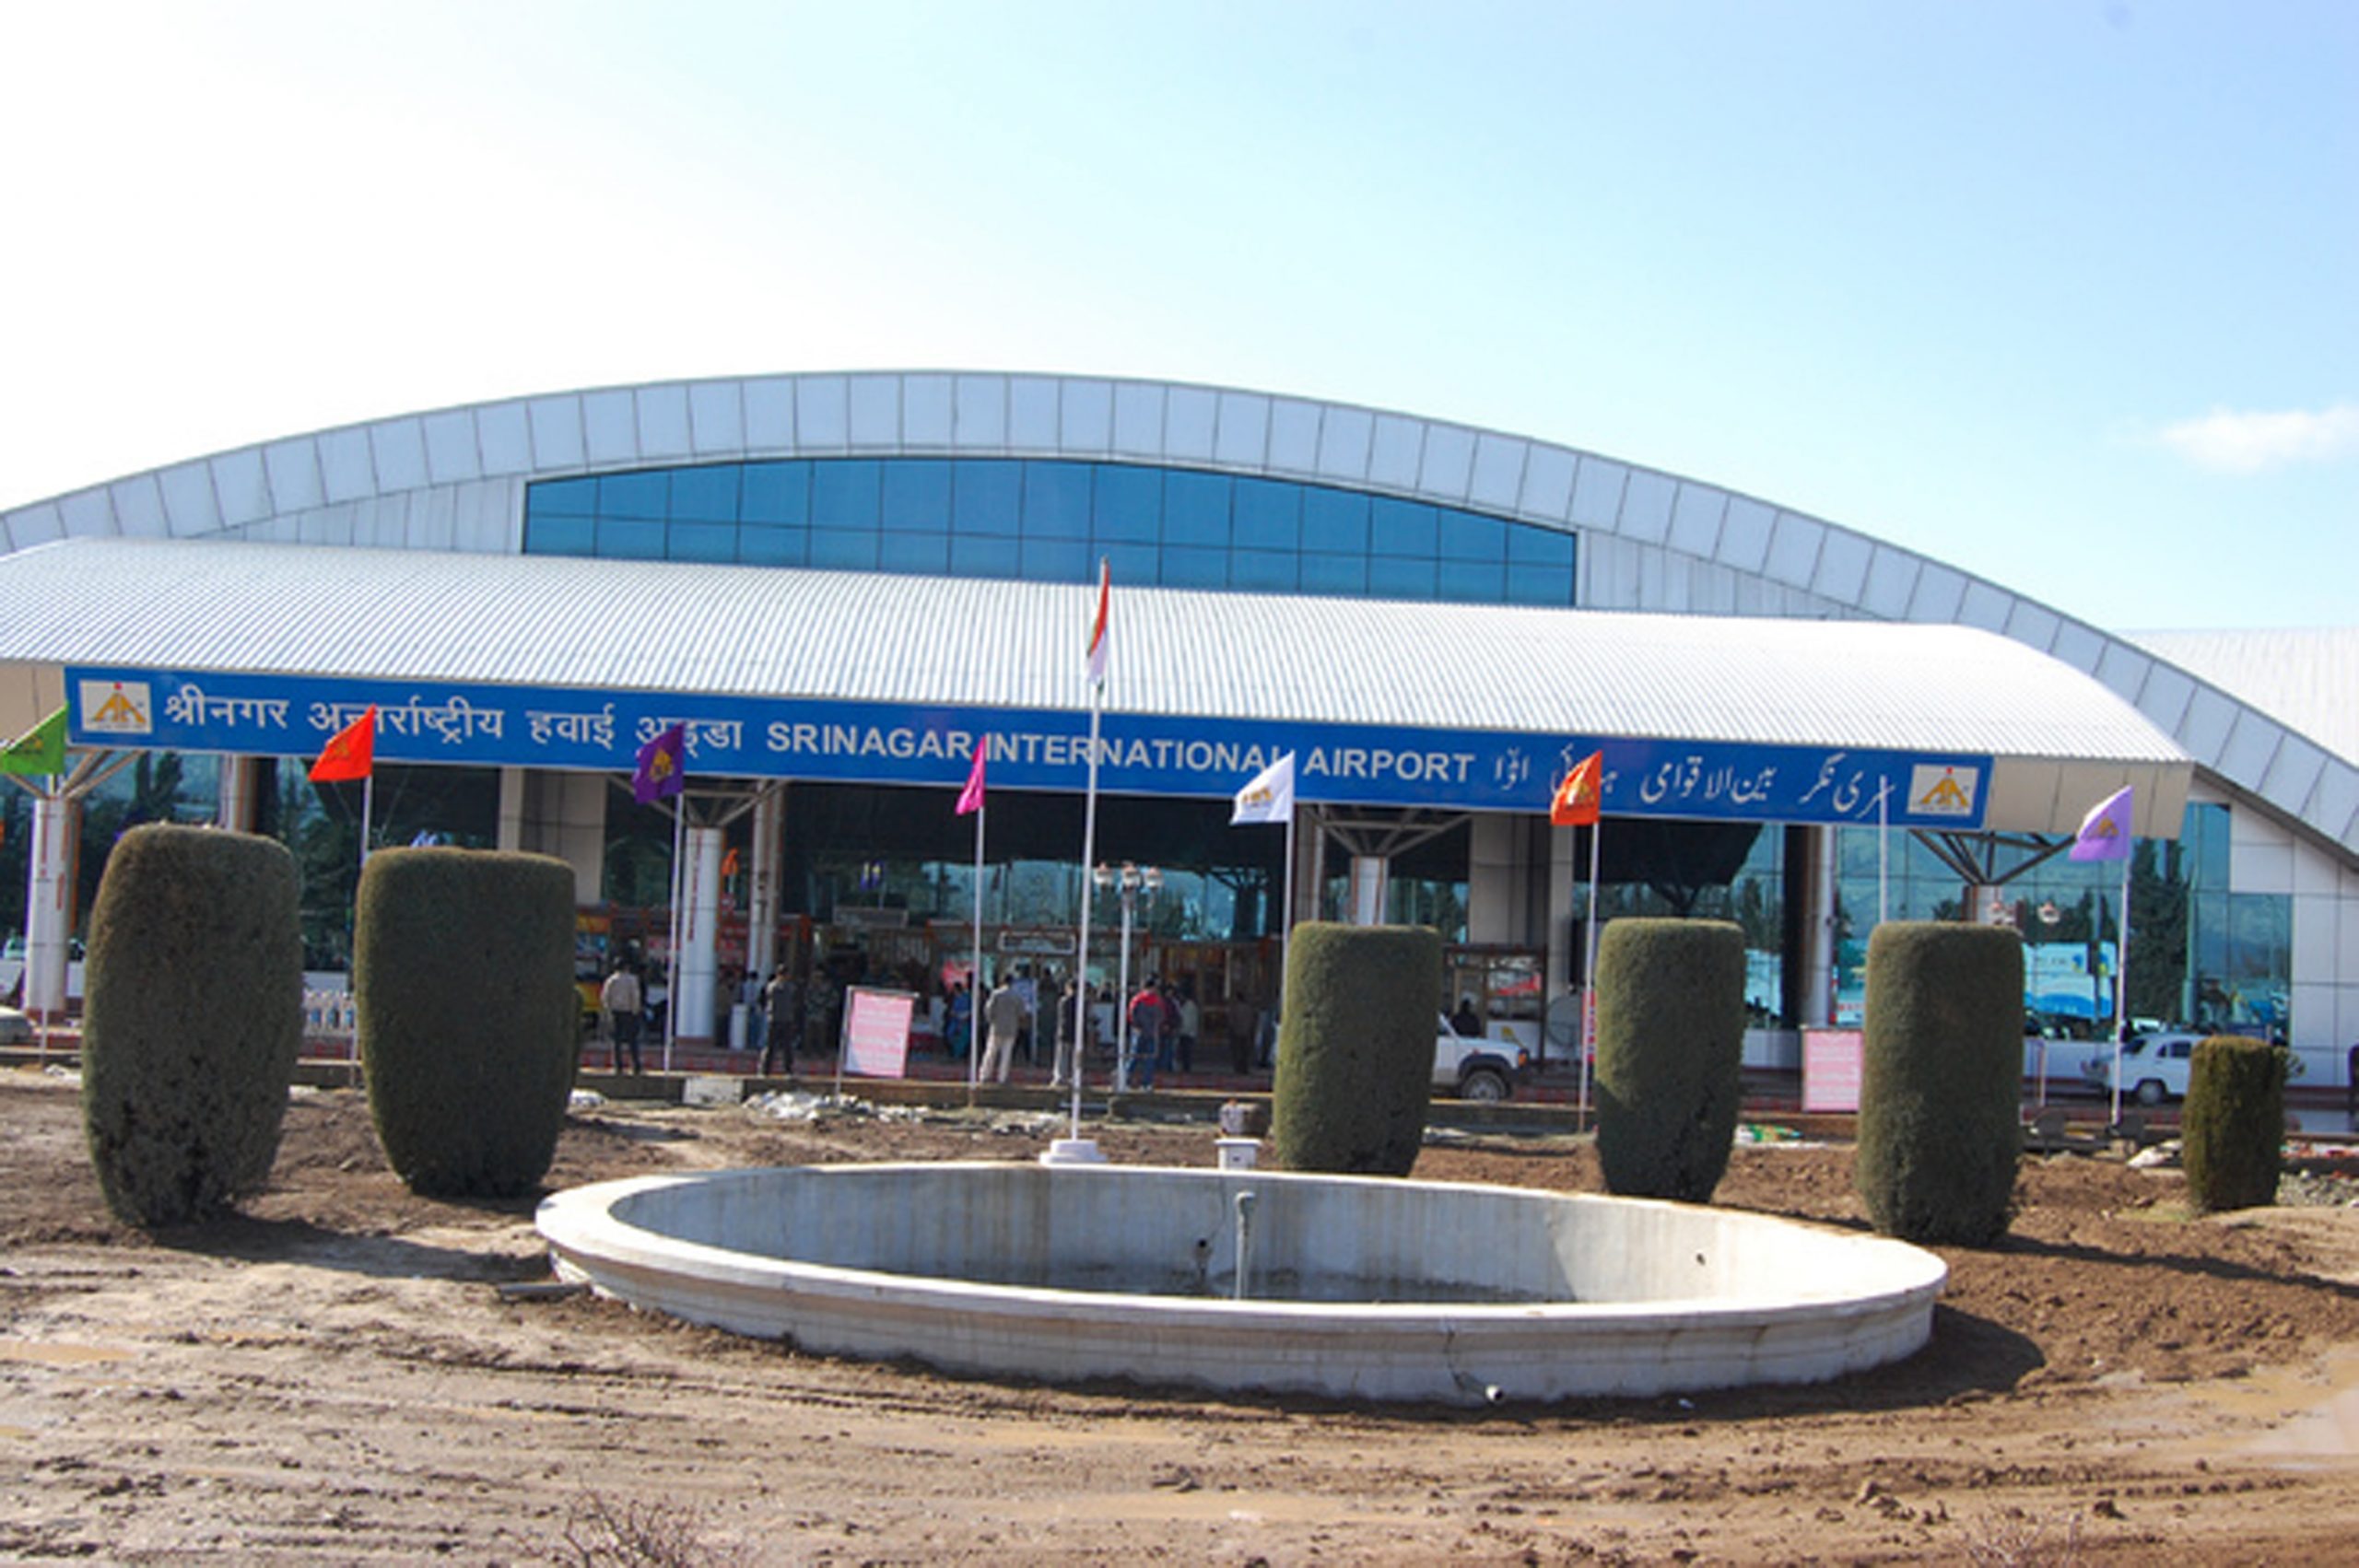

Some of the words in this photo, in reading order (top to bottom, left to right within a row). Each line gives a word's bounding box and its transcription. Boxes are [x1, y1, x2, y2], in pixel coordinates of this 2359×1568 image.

[165, 683, 290, 729] श्रीनगर
[525, 703, 615, 750] हवाई
[767, 722, 973, 761] SRINAGAR
[1302, 747, 1474, 784] AIRPORT
